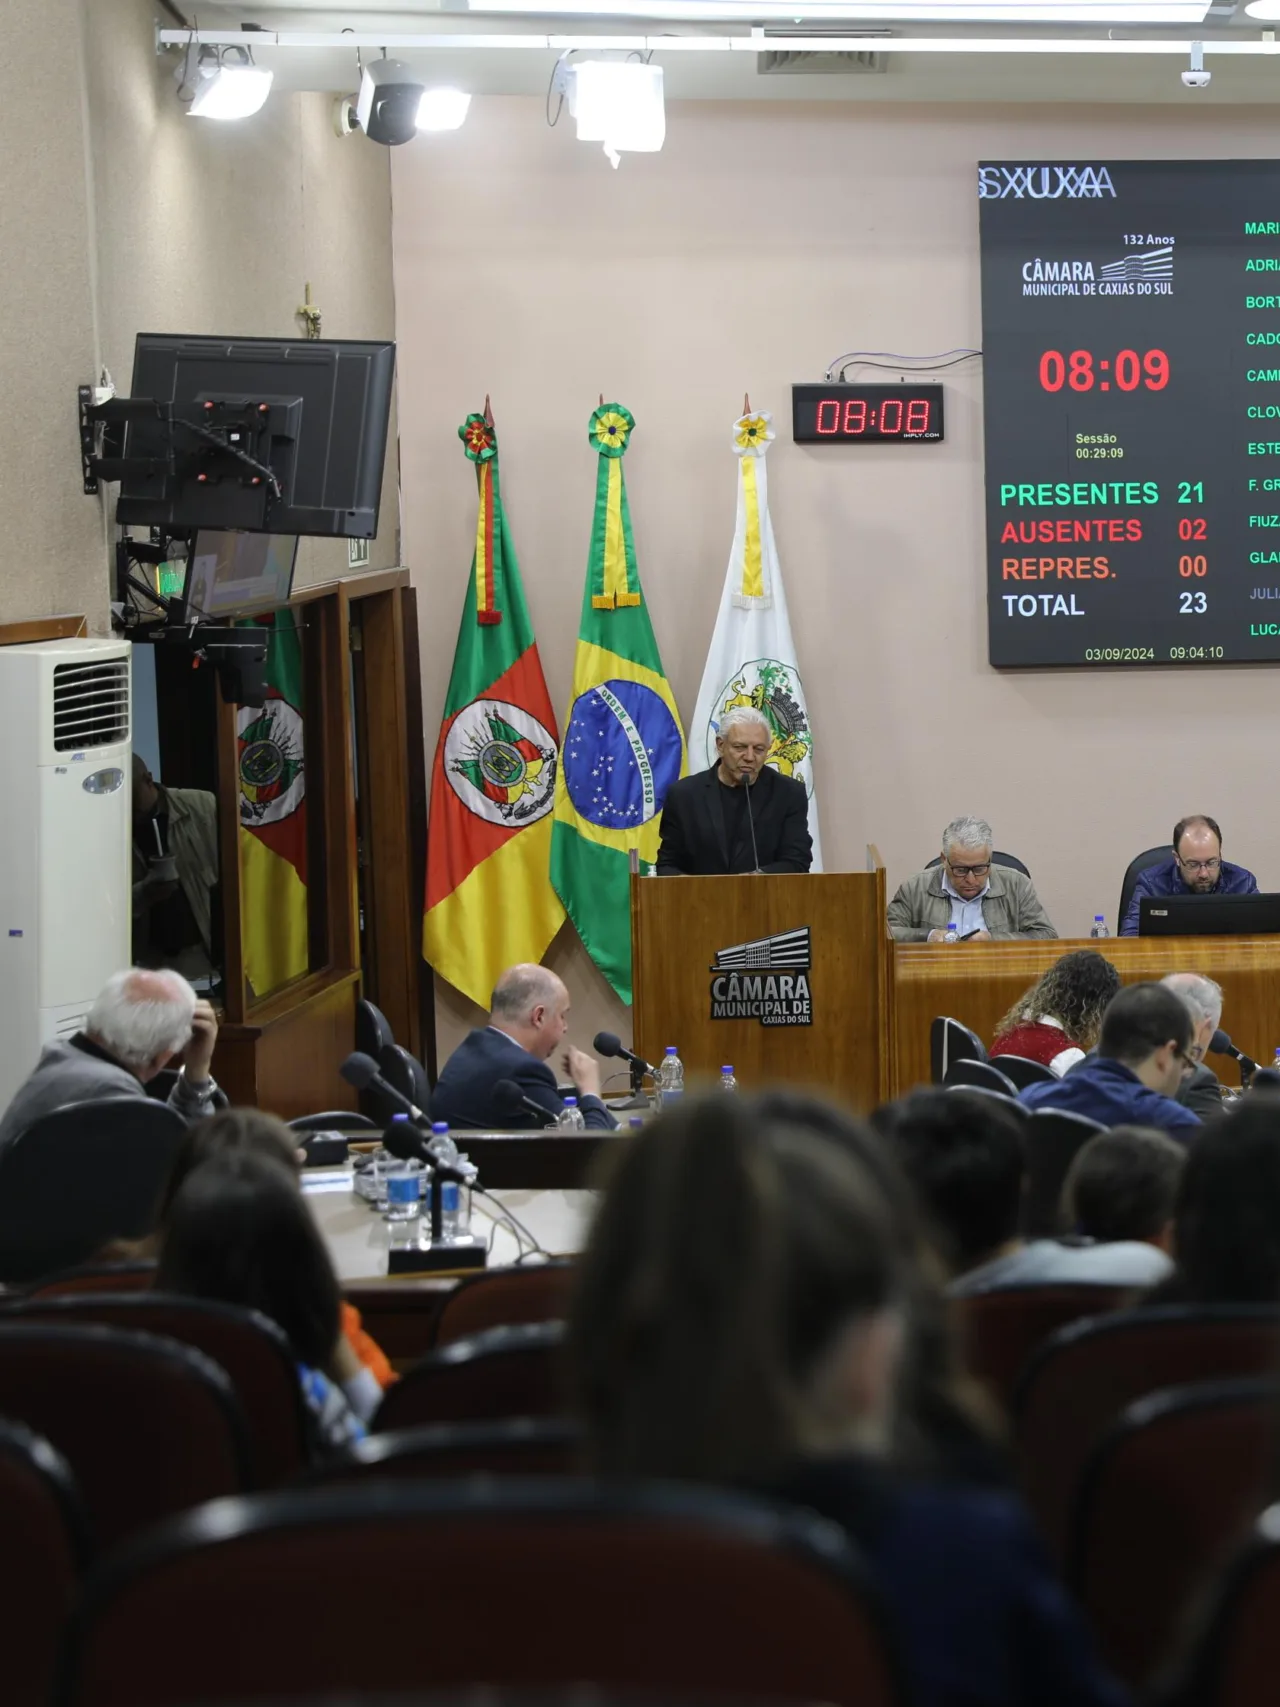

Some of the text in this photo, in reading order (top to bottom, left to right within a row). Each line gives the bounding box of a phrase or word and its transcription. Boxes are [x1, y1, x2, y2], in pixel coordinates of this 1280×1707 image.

[1124, 234, 1175, 245] 132 Anos
[1022, 258, 1095, 282] CÂMARA
[1023, 283, 1173, 296] MUNICIPAL DE CAXIAS DO SUL
[1040, 349, 1169, 392] 08:09
[816, 400, 930, 434] 08:08
[1076, 433, 1117, 444] Sessão
[1076, 447, 1124, 459] 00:29:09
[1001, 482, 1158, 506] PRESENTES
[1178, 482, 1202, 503] 21
[1249, 480, 1258, 491] F.
[1002, 519, 1142, 543] AUSENTES
[1179, 519, 1206, 540] 02
[1003, 557, 1115, 579] REPRES.
[1180, 556, 1206, 577] 00
[1003, 594, 1084, 616] TOTAL
[1180, 592, 1207, 613] 23
[1086, 648, 1154, 660] 03/09/2024
[1170, 647, 1223, 658] 09:04:10
[601, 690, 654, 804] ORDEM E PROGRESSO
[712, 972, 810, 1001] CÂMARA
[713, 1000, 810, 1017] MUNICIPAL DE
[762, 1016, 786, 1024] CAXIAS
[797, 1015, 811, 1023] SUL
